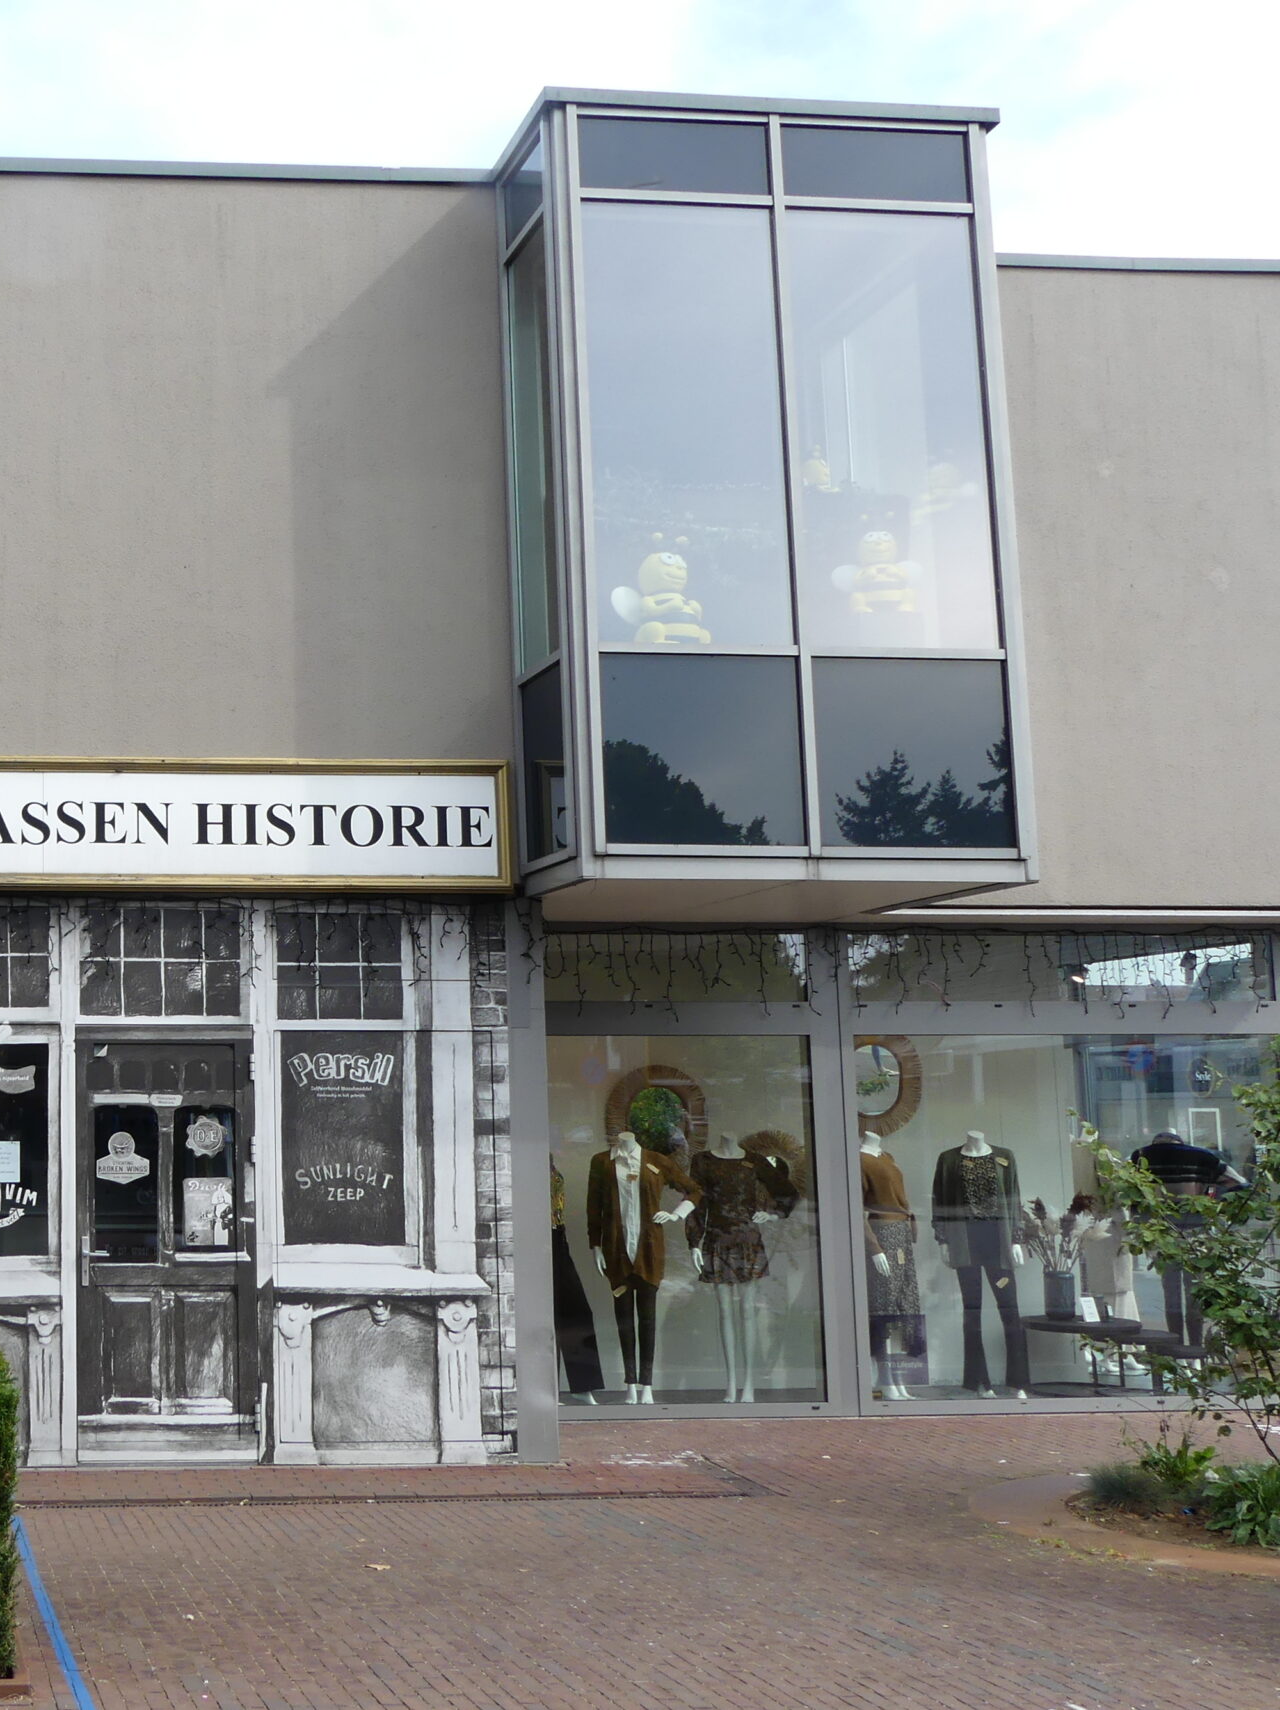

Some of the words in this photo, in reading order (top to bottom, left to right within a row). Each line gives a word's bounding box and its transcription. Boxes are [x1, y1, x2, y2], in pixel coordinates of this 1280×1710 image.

[192, 803, 495, 848] HISTORIE
[287, 1053, 394, 1087] Persil
[126, 1165, 148, 1173] WINGS
[295, 1163, 393, 1189] SUNLIGHT
[5, 1183, 38, 1206] VIM
[327, 1187, 365, 1201] ZEEP
